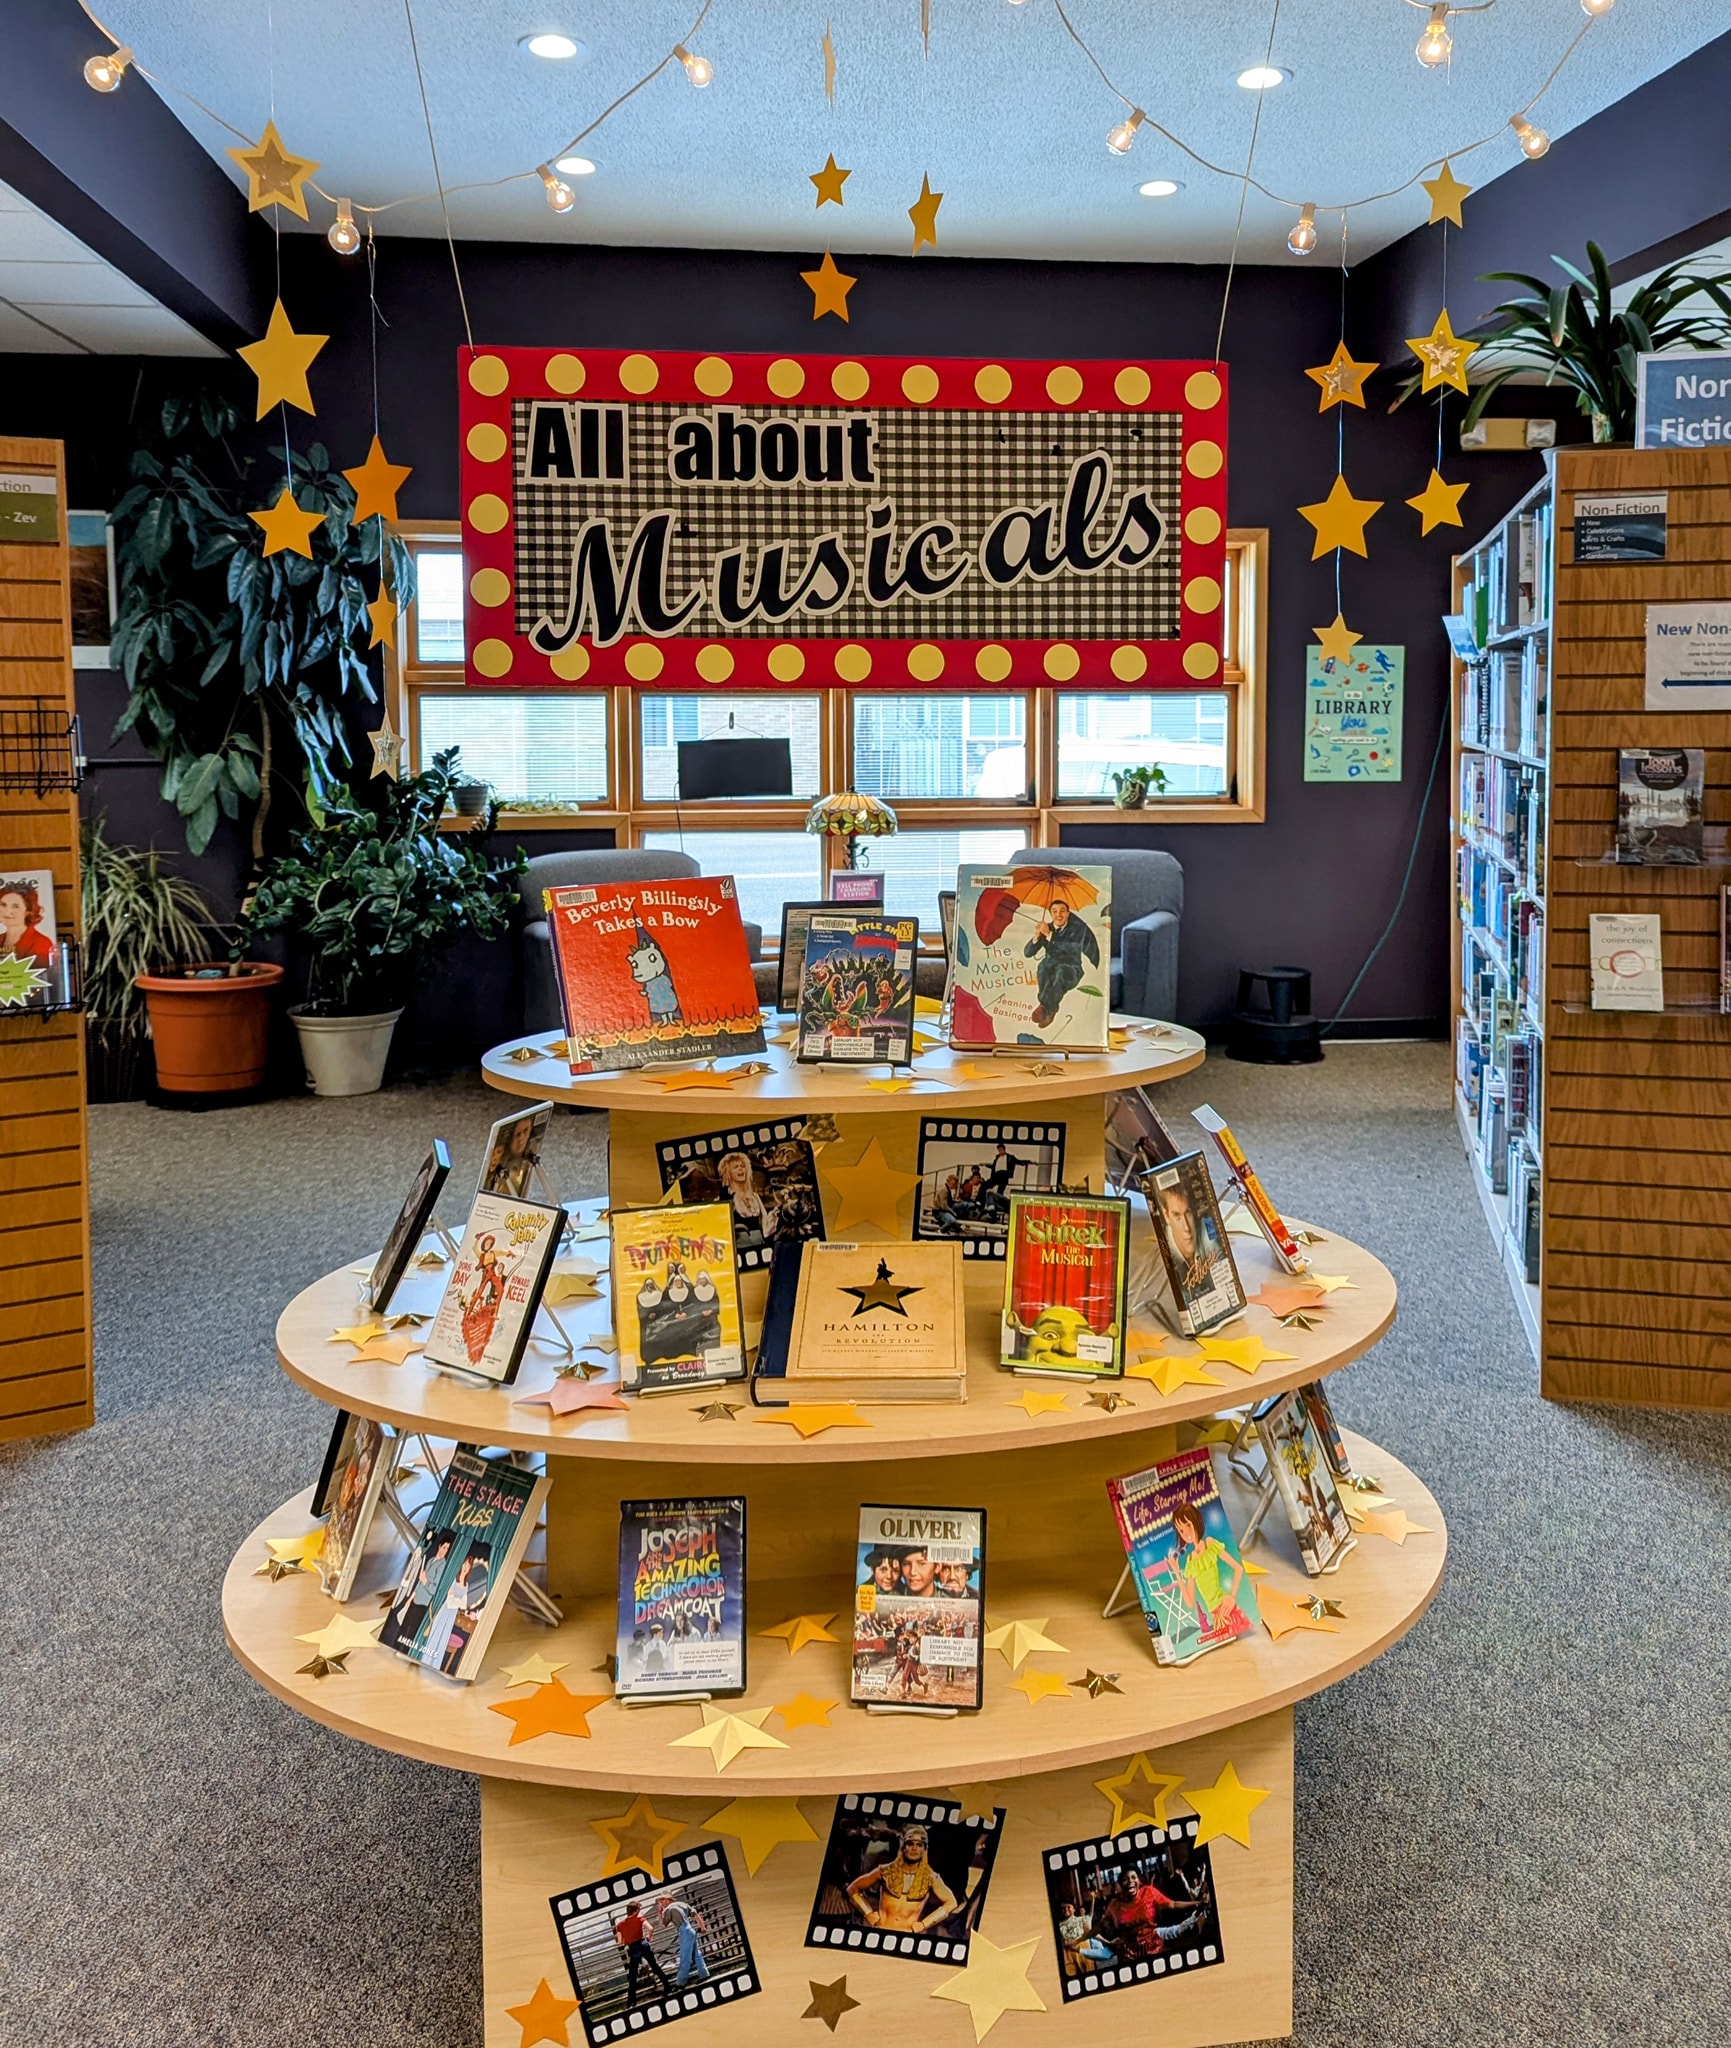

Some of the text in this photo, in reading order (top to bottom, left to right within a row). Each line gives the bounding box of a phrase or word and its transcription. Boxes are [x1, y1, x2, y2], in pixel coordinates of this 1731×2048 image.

[525, 402, 878, 486] All about
[0, 480, 31, 492] tion
[13, 512, 37, 523] Zev
[1581, 503, 1660, 516] Non-Fiction
[531, 451, 1168, 654] Musicals
[1657, 624, 1692, 636] New
[1315, 700, 1392, 715] LIBRARY
[1641, 762, 1683, 774] lessons
[565, 890, 723, 925] Beverly Billingsly
[593, 911, 700, 935] Takes a Bow
[1606, 924, 1619, 932] the
[1622, 924, 1635, 933] joy
[983, 946, 1011, 958] The
[976, 958, 1024, 975] Movie
[998, 996, 1033, 1010] Jeanine
[993, 1007, 1032, 1022] Basinger
[627, 1043, 712, 1060] ALEXANDER STADLER
[1280, 1238, 1294, 1247] YA
[624, 1233, 725, 1271] NUNSENSE
[452, 1270, 471, 1287] DAY
[506, 1285, 526, 1303] KEEL
[824, 1323, 934, 1331] HAMILTON
[672, 1371, 705, 1380] Broadway
[447, 1474, 524, 1515] THE STAGE
[1133, 1473, 1206, 1524] Life, Starring Me!
[450, 1498, 494, 1528] Kiss
[880, 1518, 962, 1539] OLIVER!
[638, 1522, 717, 1563] JOSEPH
[635, 1553, 721, 1586] AMAZING
[634, 1576, 725, 1601] TECHNICOLOR
[635, 1596, 725, 1624] DREAMCOAT
[397, 1634, 438, 1659] AMELIA JONES
